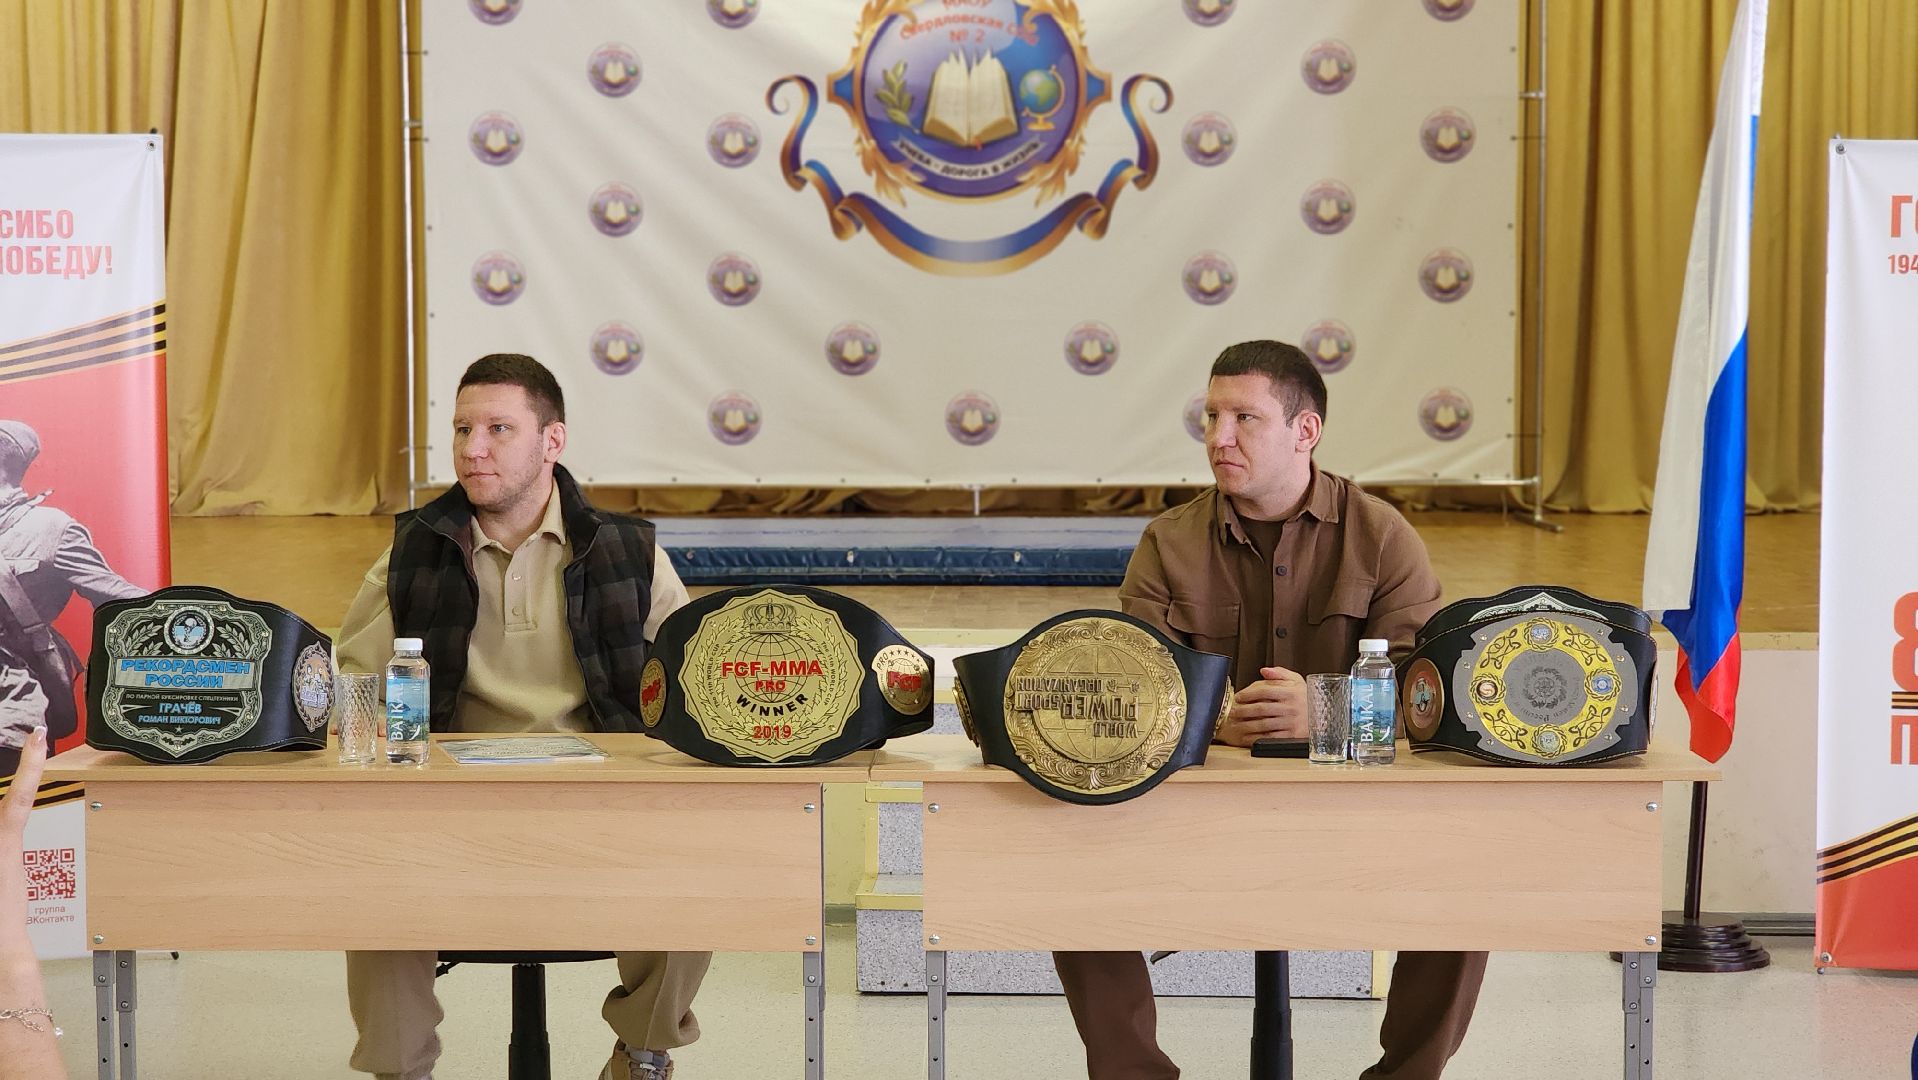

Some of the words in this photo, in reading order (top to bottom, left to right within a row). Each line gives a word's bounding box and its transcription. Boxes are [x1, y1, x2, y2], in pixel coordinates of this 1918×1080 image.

[976, 29, 986, 43] 2
[941, 165, 988, 178] ДОРОГА
[0, 245, 113, 280] ОБЕДУ!
[120, 658, 250, 675] РЕКОРДСМЕН
[706, 657, 714, 680] WORLD
[721, 659, 825, 679] FCF-MMA
[876, 652, 889, 670] PRO
[145, 674, 224, 688] РОССИИ
[754, 679, 787, 693] PRO
[1016, 676, 1103, 693] ORGANIZATION
[159, 701, 202, 714] ГРАЧЁВ
[736, 693, 809, 717] WINNER
[1360, 683, 1374, 742] BAIKAL
[138, 715, 169, 724] РОМАН
[170, 715, 222, 725] ВИКТОРОВИЧ
[752, 724, 793, 740] 2019
[1093, 721, 1138, 739] WORLD
[35, 905, 66, 915] группа
